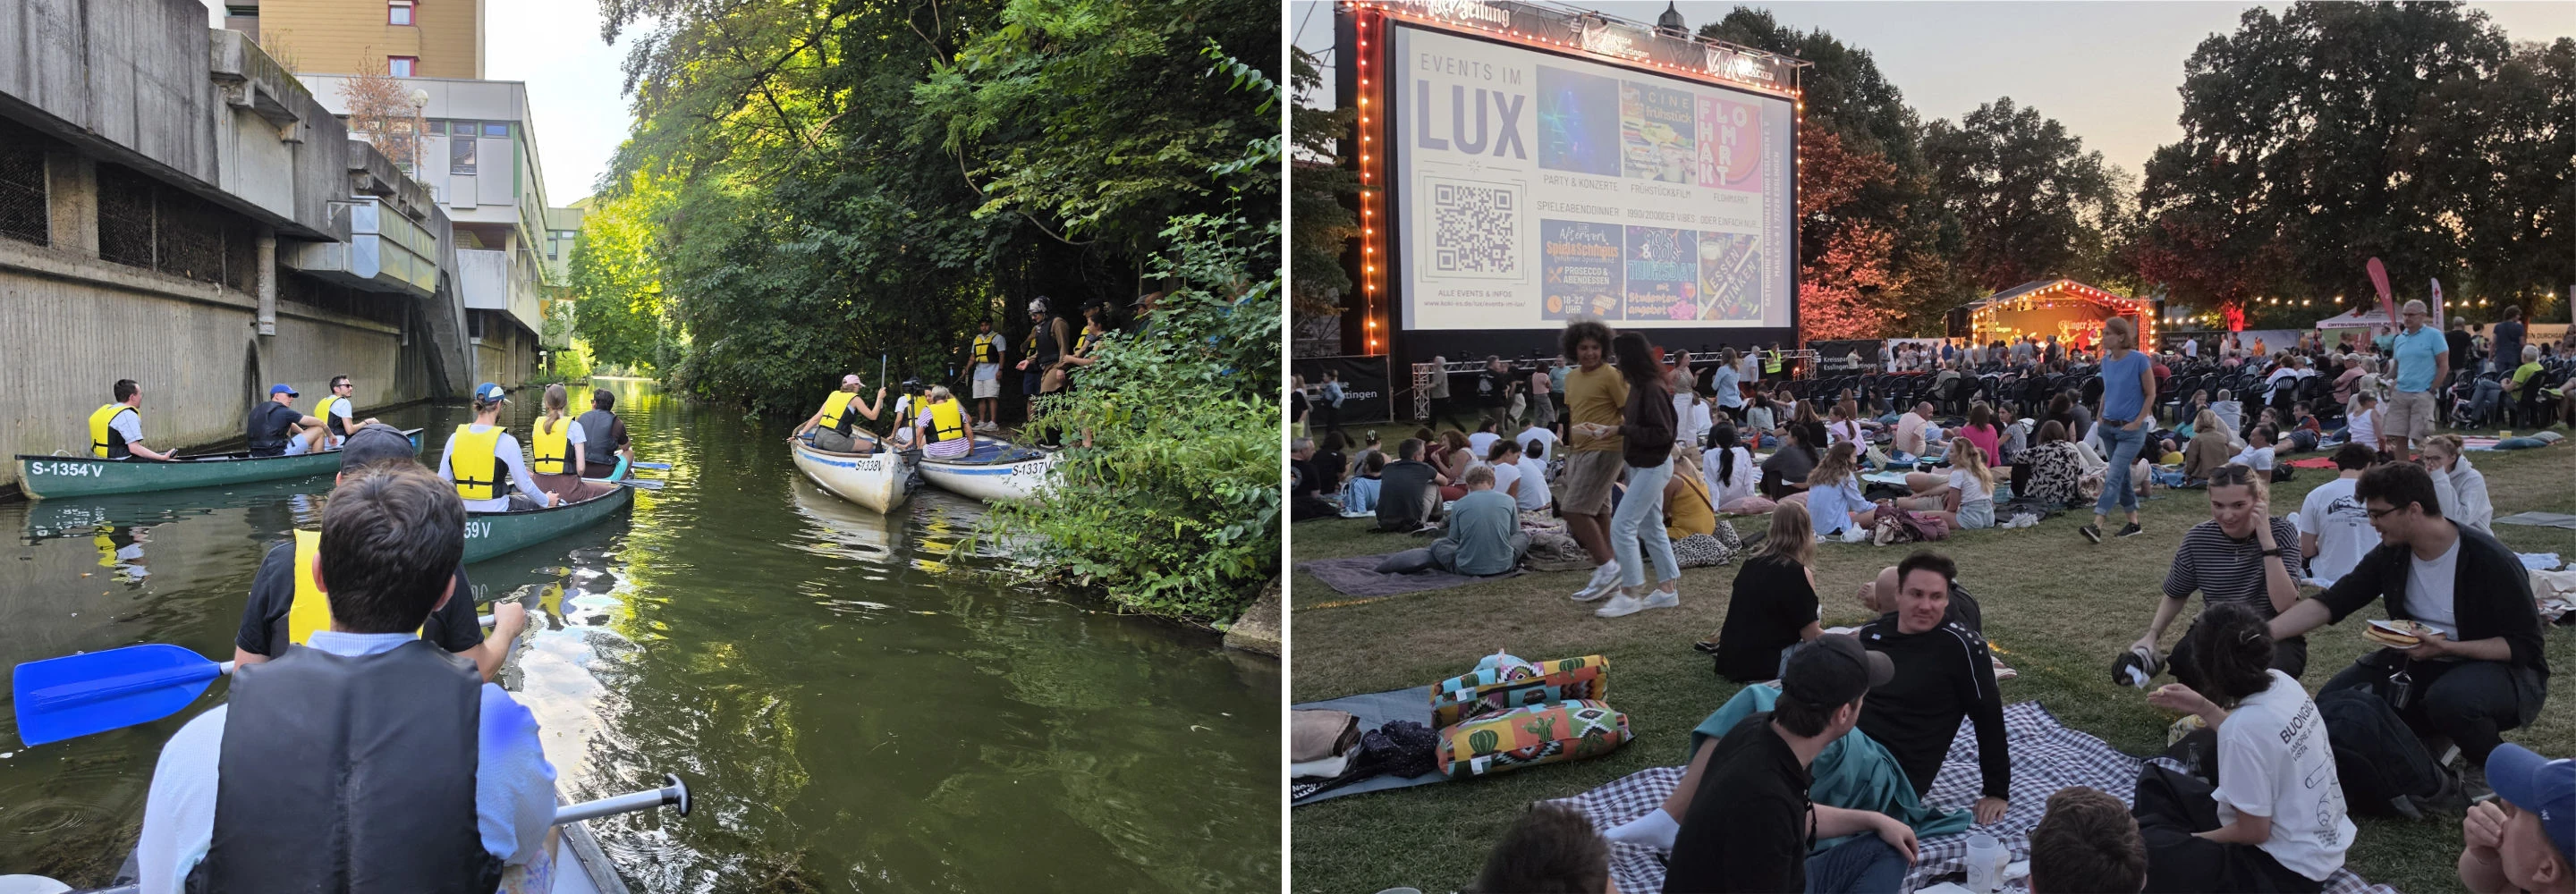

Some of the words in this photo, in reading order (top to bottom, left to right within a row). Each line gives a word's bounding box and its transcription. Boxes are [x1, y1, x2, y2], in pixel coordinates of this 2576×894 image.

[1420, 53, 1492, 80] EVENTS
[1503, 66, 1521, 85] IM
[1648, 91, 1690, 108] CINE
[1417, 78, 1527, 161] LUX
[1544, 174, 1569, 186] PARTY
[1579, 178, 1618, 192] KONZERTE
[1537, 200, 1620, 216] SPIELEABENDDINNER
[1677, 211, 1696, 224] VIBES
[1564, 266, 1602, 276] PROSECCO
[1627, 259, 1697, 283] THURSDAY
[1709, 249, 1740, 290] ESSEN
[1563, 275, 1610, 285] ABENDESSEN
[1716, 261, 1758, 313] TRINKEN
[1437, 289, 1454, 297] ALLE
[1457, 290, 1484, 298] EVENTS
[1492, 290, 1513, 298] INFOS
[1562, 295, 1584, 305] 18-22
[1565, 305, 1581, 315] UHR
[481, 521, 491, 539] V
[2292, 744, 2309, 763] VISTA
